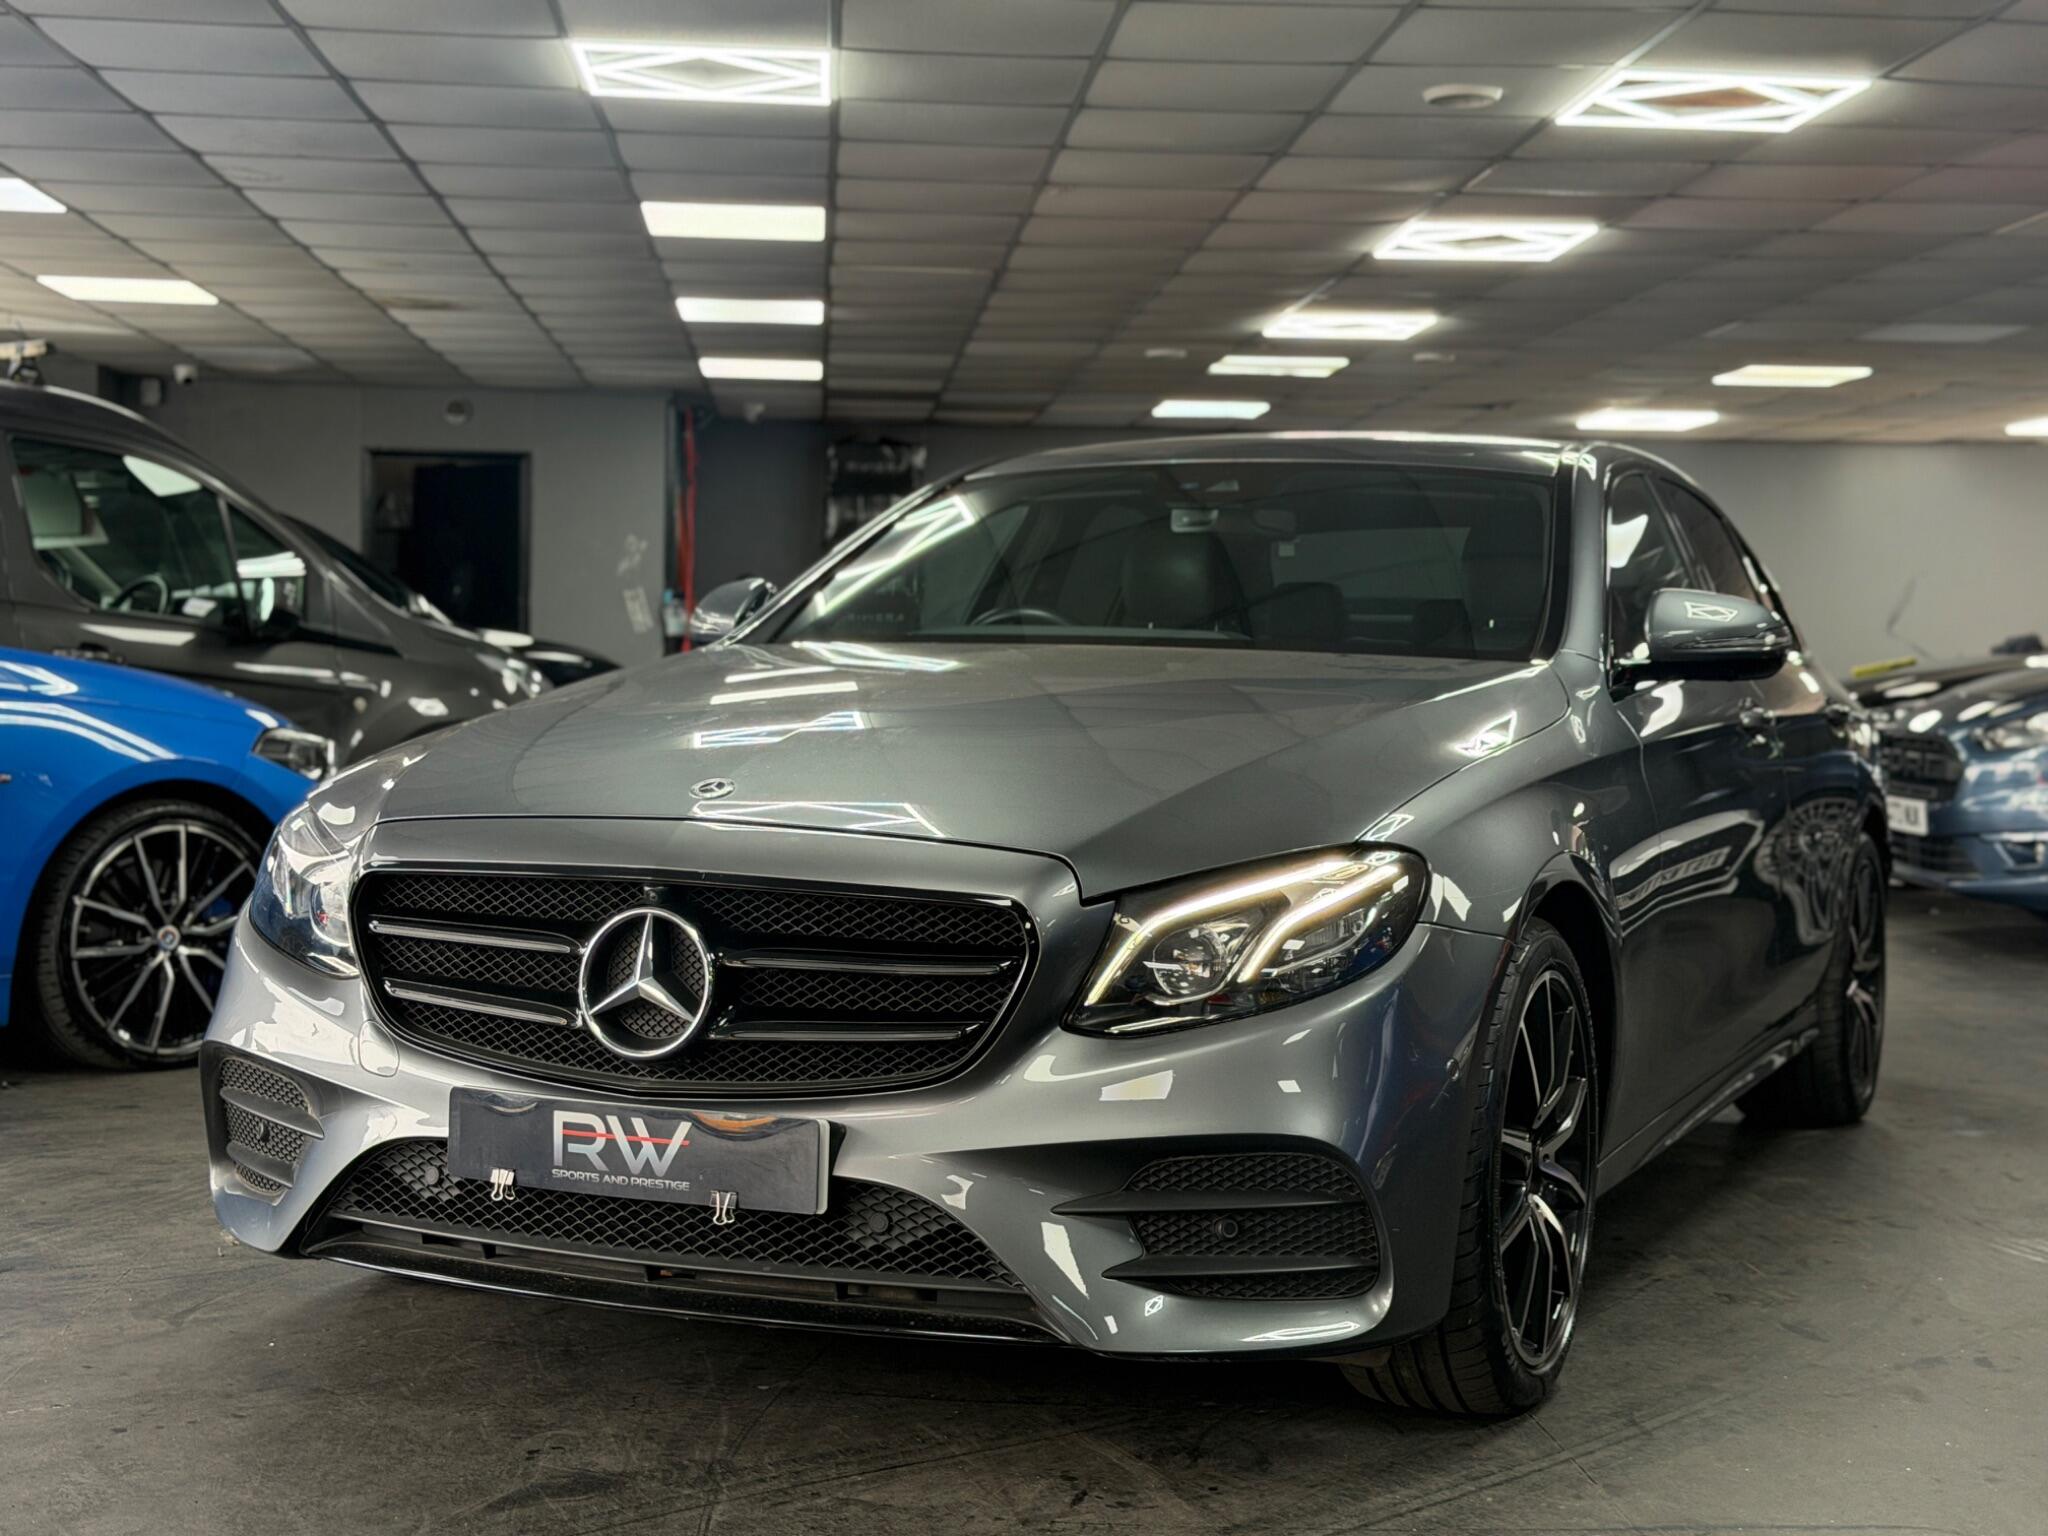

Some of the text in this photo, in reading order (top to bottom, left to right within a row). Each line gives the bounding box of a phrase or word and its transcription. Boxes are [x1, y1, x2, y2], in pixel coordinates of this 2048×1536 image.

[553, 1110, 692, 1176] RW
[552, 1169, 691, 1191] SPORTS AND PRESTIGE
